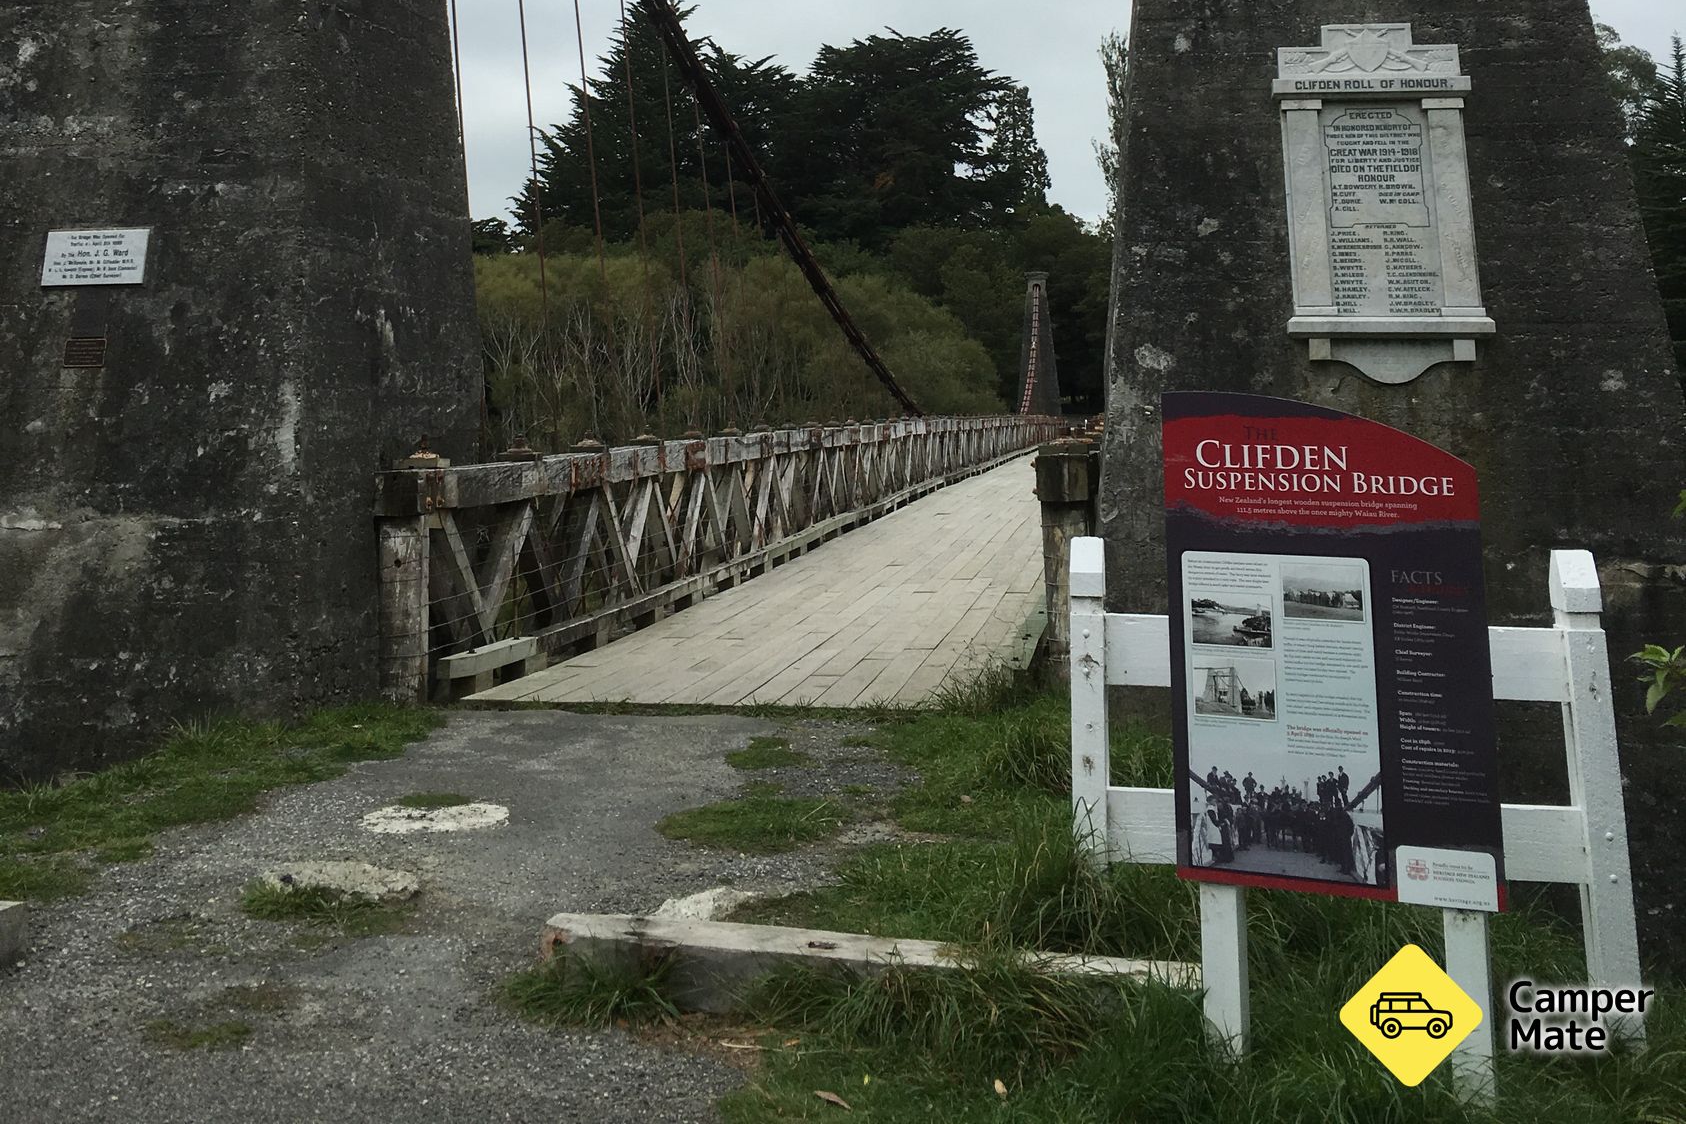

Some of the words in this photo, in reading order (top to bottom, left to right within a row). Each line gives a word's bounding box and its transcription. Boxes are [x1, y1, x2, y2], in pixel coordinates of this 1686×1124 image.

[1295, 80, 1344, 90] CLIFDEN
[1344, 80, 1373, 90] ROLL
[1380, 79, 1395, 89] OF
[1348, 112, 1393, 120] ERECTED
[1342, 124, 1375, 132] HONORED
[1330, 148, 1358, 157] GREAT
[1358, 148, 1378, 156] WAR
[1331, 164, 1351, 173] DIED
[1353, 164, 1365, 173] ON
[1367, 164, 1384, 172] THE
[1385, 164, 1410, 172] FIELD
[1358, 174, 1396, 182] HONOUR
[113, 249, 128, 257] Ward
[1243, 425, 1277, 441] THE
[1195, 439, 1348, 471] CLIFDEN
[1184, 468, 1340, 493] SUSPENSION
[1352, 472, 1454, 496] BRIDGE
[1235, 496, 1266, 505] Zealand's
[1268, 498, 1293, 507] longest
[1321, 500, 1359, 508] suspension
[1360, 500, 1384, 510] bridge
[1384, 502, 1418, 510] spanning
[1277, 508, 1298, 516] above
[1298, 508, 1310, 516] the
[1328, 510, 1353, 518] mighty
[1354, 510, 1378, 518] Waiau
[1391, 570, 1443, 585] FACTS
[1402, 758, 1434, 766] Construction
